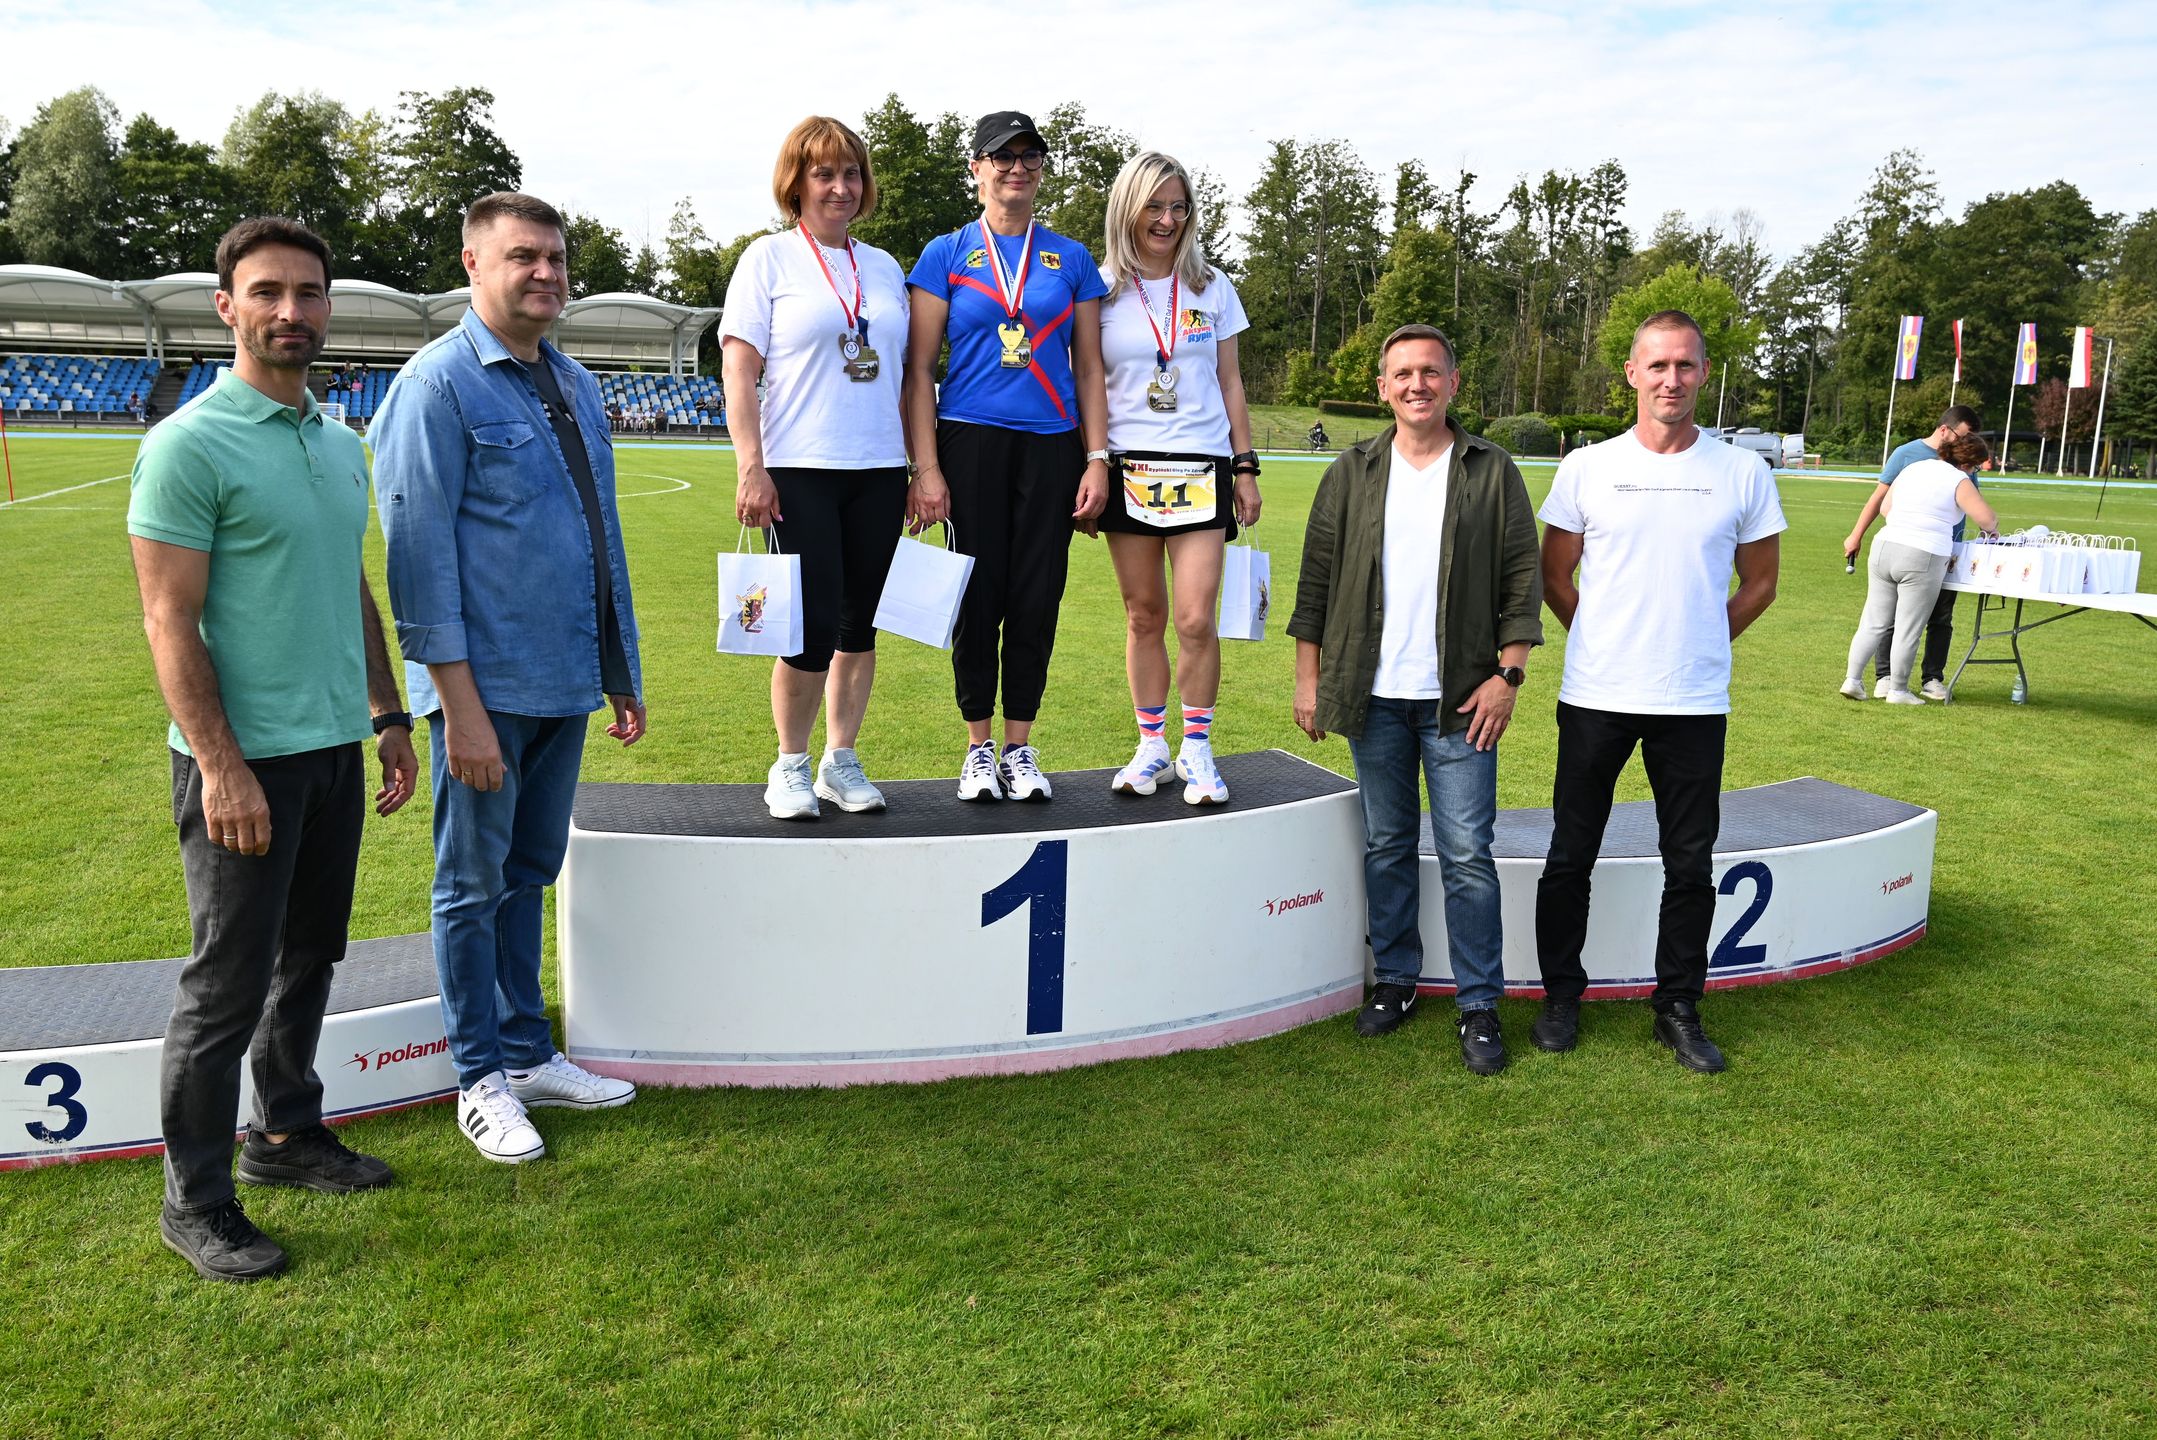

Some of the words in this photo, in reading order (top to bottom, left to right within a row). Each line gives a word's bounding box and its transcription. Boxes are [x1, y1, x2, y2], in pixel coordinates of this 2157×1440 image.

[1148, 482, 1191, 507] 11
[1278, 889, 1324, 915] polanik
[1889, 872, 1914, 895] polanik
[981, 839, 1068, 1036] 1
[1709, 861, 1773, 969] 2
[24, 1062, 88, 1144] 3
